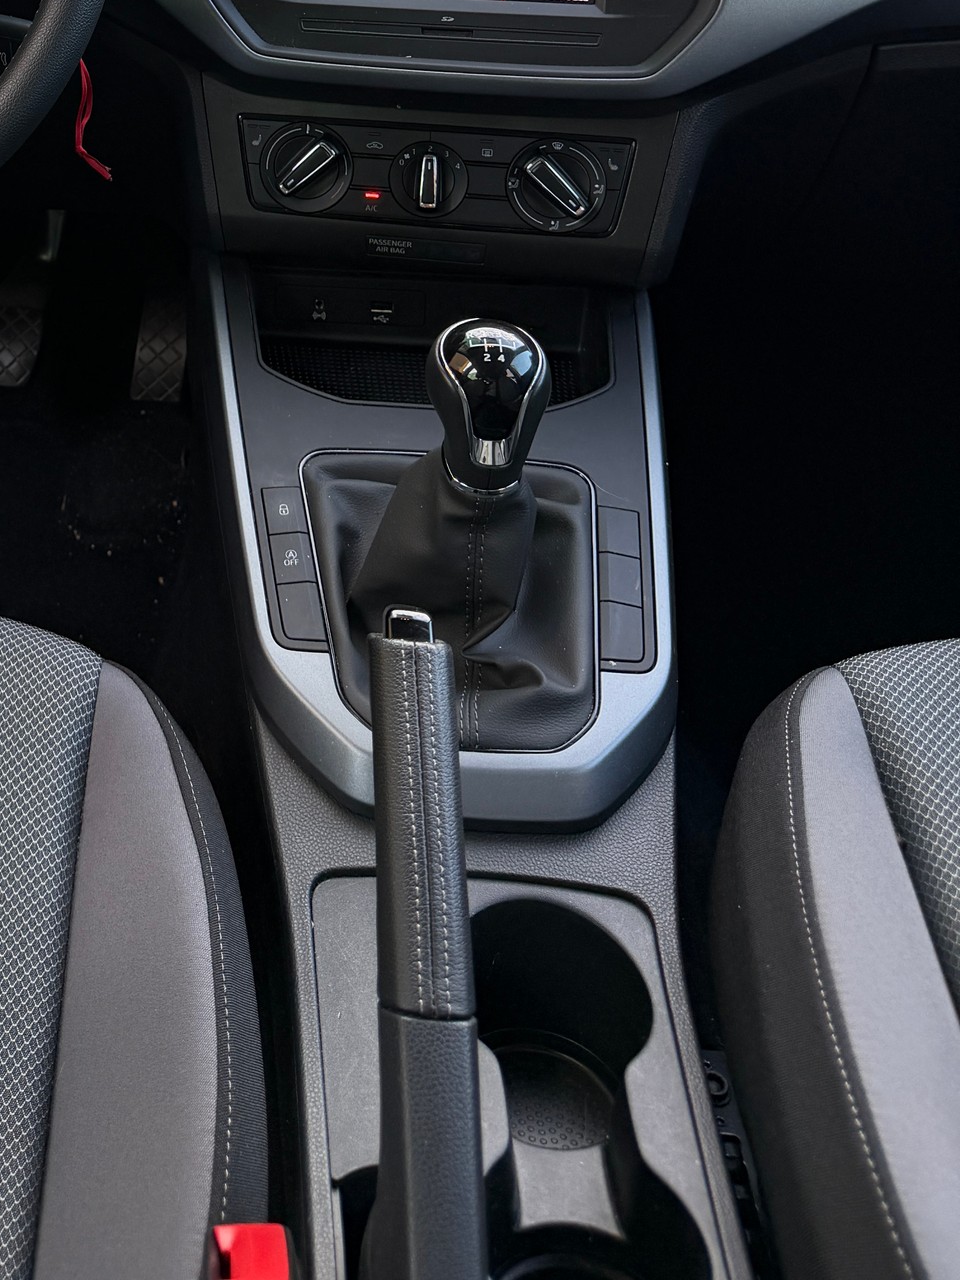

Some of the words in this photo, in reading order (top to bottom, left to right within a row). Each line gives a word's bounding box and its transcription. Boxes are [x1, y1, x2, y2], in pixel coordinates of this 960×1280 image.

[368, 238, 413, 248] PASSENGER
[483, 353, 492, 362] 2
[497, 354, 506, 363] 4
[283, 558, 299, 566] OFF
